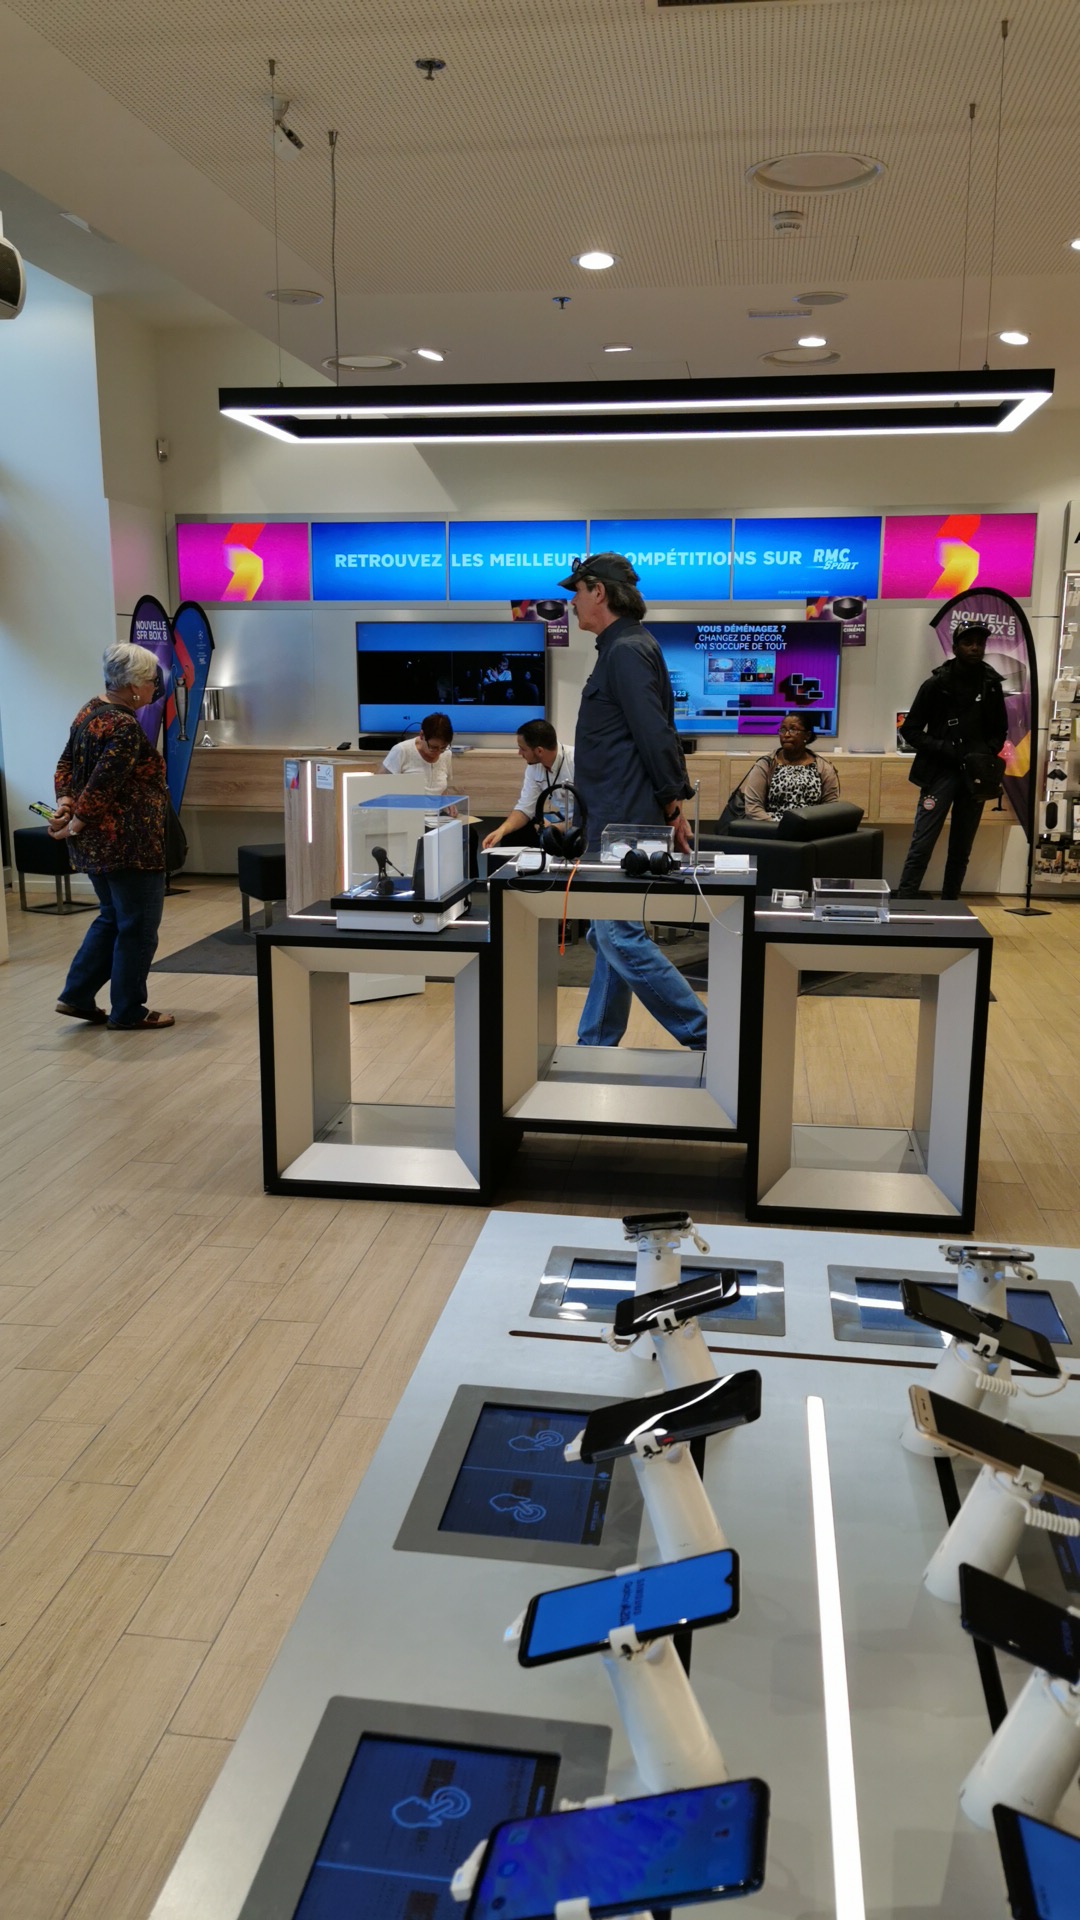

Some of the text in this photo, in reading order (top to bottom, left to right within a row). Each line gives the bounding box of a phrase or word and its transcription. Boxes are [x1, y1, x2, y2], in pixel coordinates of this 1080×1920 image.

[335, 553, 442, 567] RETROUVEZ
[451, 553, 484, 567] LES
[616, 548, 757, 566] OMPÉTITIONS
[763, 551, 802, 565] SUR
[813, 548, 851, 563] RMC
[823, 560, 859, 570] SPORT
[951, 610, 1016, 625] NOUVELLE
[136, 621, 166, 630] NOUVELLE
[697, 623, 787, 633] VOUS DÉMÉNAGEZ ?
[987, 623, 1016, 636] OX 8
[137, 631, 167, 640] SFR BOX 8
[698, 632, 785, 643] CHANGEZ DE DÉCOR,
[694, 642, 788, 650] ON S'OCCUPE DE TOUT
